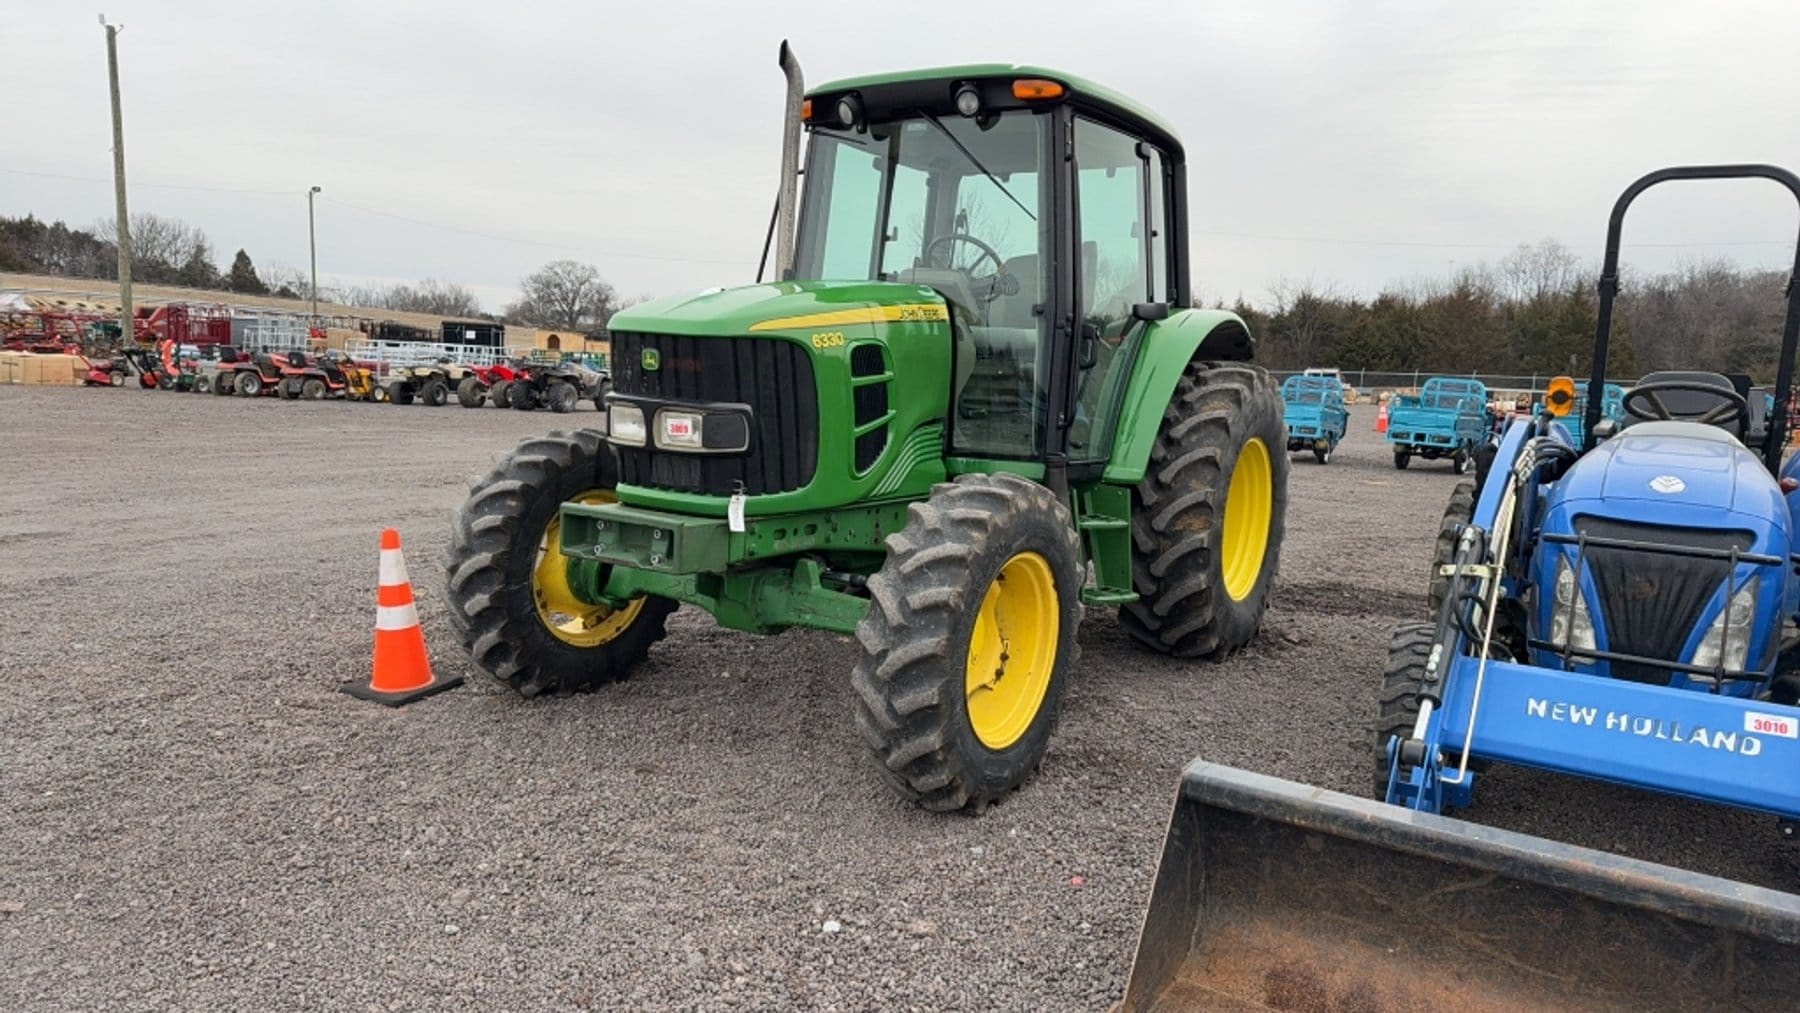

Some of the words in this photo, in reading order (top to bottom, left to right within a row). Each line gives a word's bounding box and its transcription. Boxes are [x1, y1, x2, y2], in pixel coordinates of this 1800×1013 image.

[899, 307, 919, 320] JOHN
[917, 305, 940, 320] DEERE
[811, 331, 845, 348] 6330
[1526, 697, 1598, 726] NEW
[1606, 711, 1762, 756] HOLLAND
[1753, 719, 1788, 735] 3010
